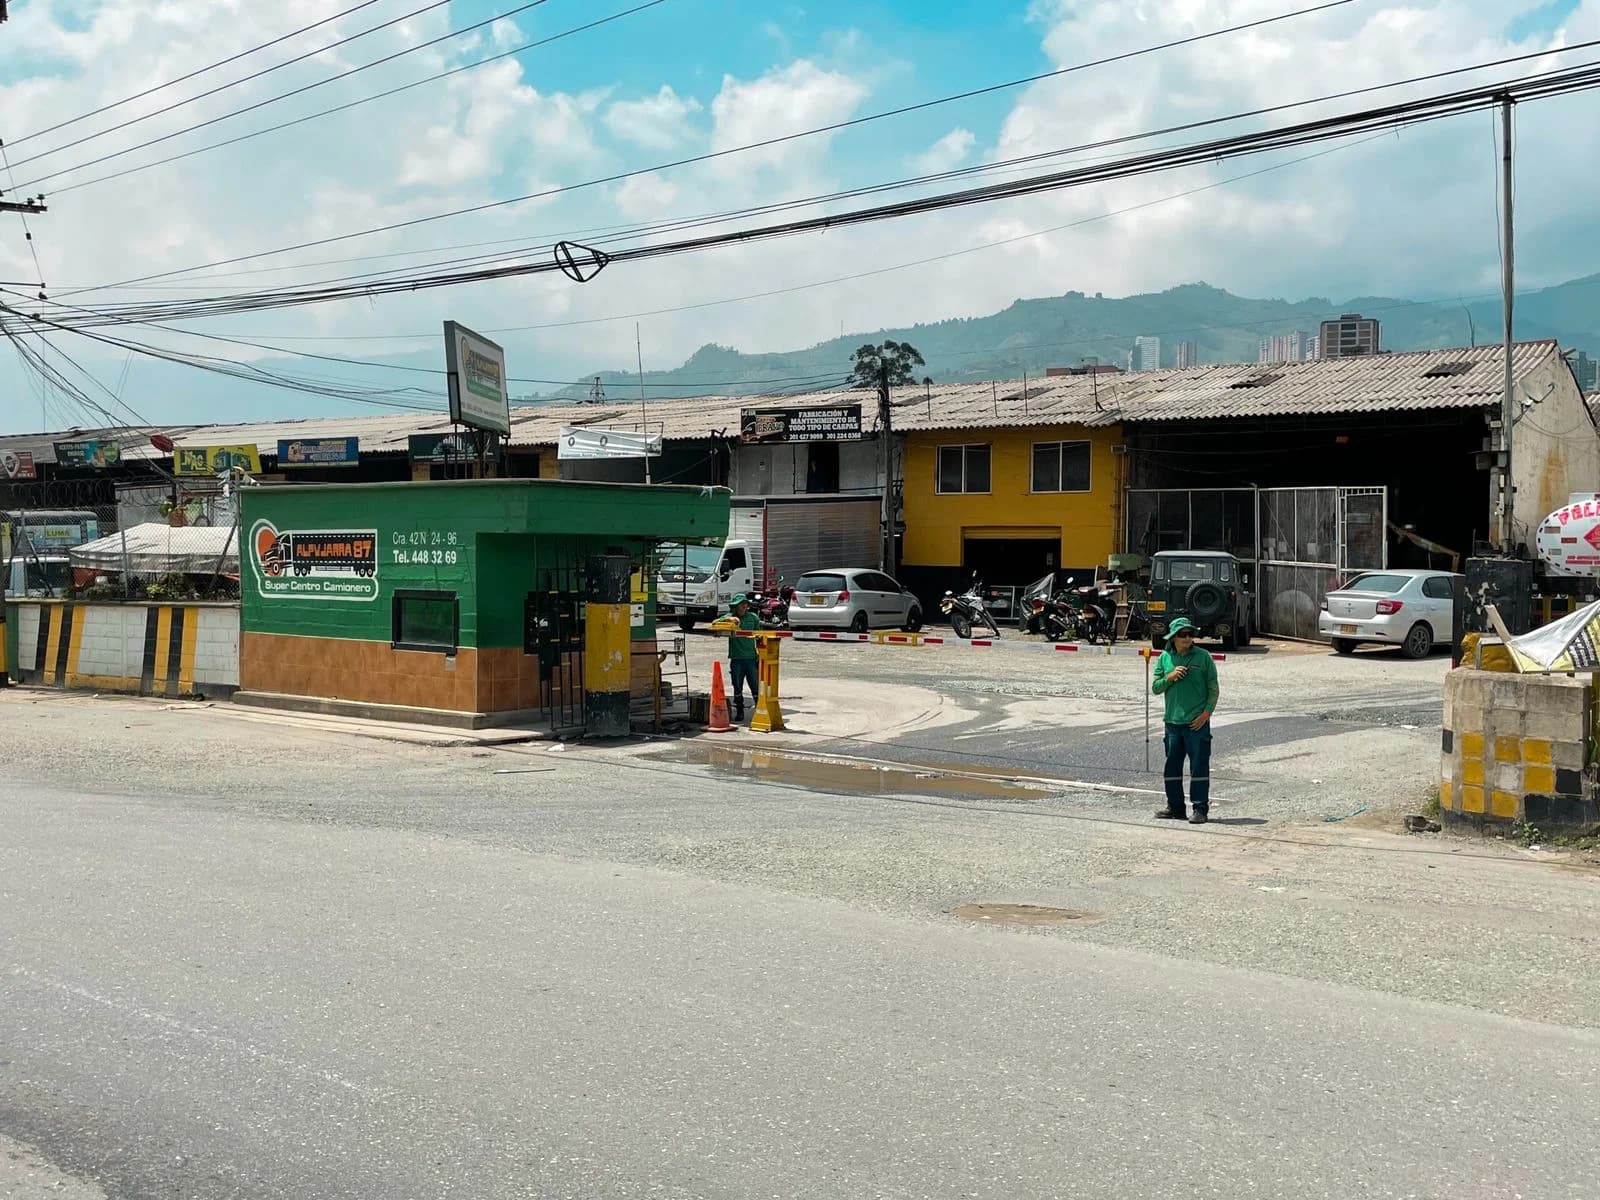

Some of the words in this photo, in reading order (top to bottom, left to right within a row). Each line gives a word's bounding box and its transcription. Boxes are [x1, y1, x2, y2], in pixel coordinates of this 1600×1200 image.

[798, 409, 842, 418] FABRICACIÓN
[842, 409, 849, 417] Y
[790, 416, 847, 425] MANTENIMIENTO
[409, 532, 419, 545] 42
[431, 532, 441, 545] 24
[447, 532, 457, 545] 96
[353, 540, 372, 558] 87
[392, 550, 410, 564] Tel.
[411, 550, 429, 564] 448
[431, 550, 443, 564] 32
[445, 550, 457, 564] 69
[265, 581, 289, 592] Super
[290, 581, 321, 590] Centro
[323, 582, 371, 592] Camionero
